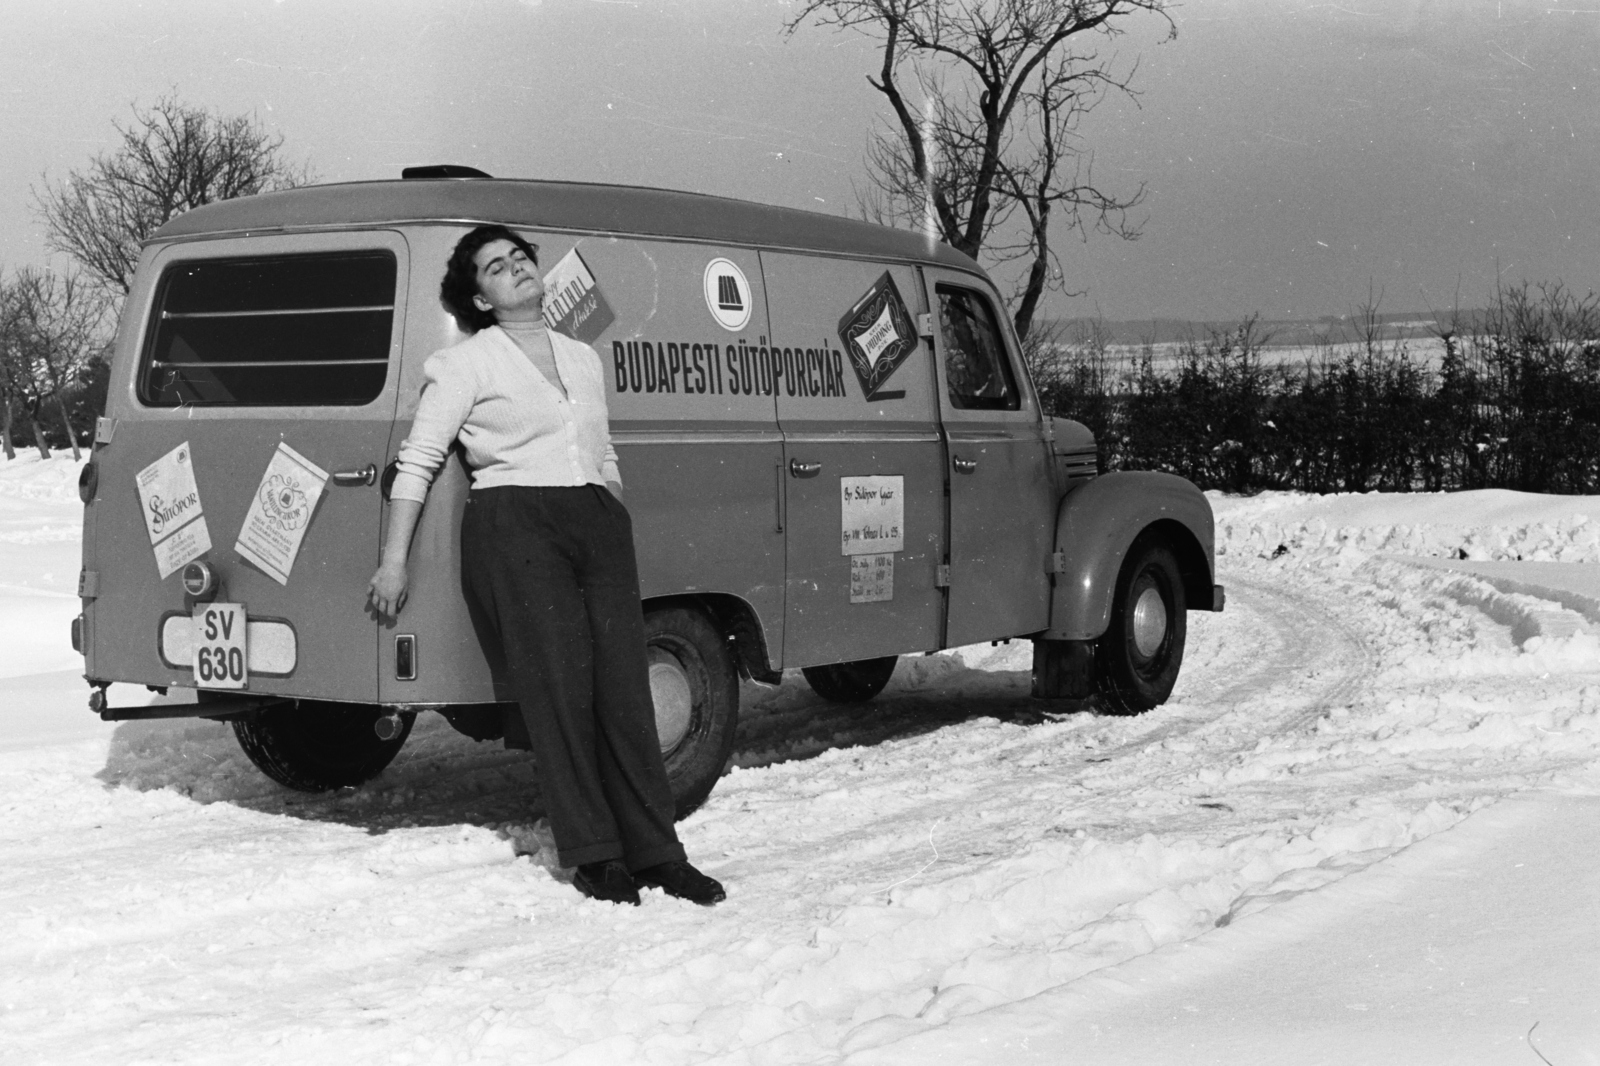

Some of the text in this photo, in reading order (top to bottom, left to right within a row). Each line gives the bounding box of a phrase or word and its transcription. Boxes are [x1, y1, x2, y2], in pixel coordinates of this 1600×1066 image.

[865, 320, 893, 354] PUDDING
[612, 335, 846, 398] BUDAPESTI SÜTŐPORGYÁR
[205, 610, 234, 640] SV
[199, 647, 243, 681] 630
